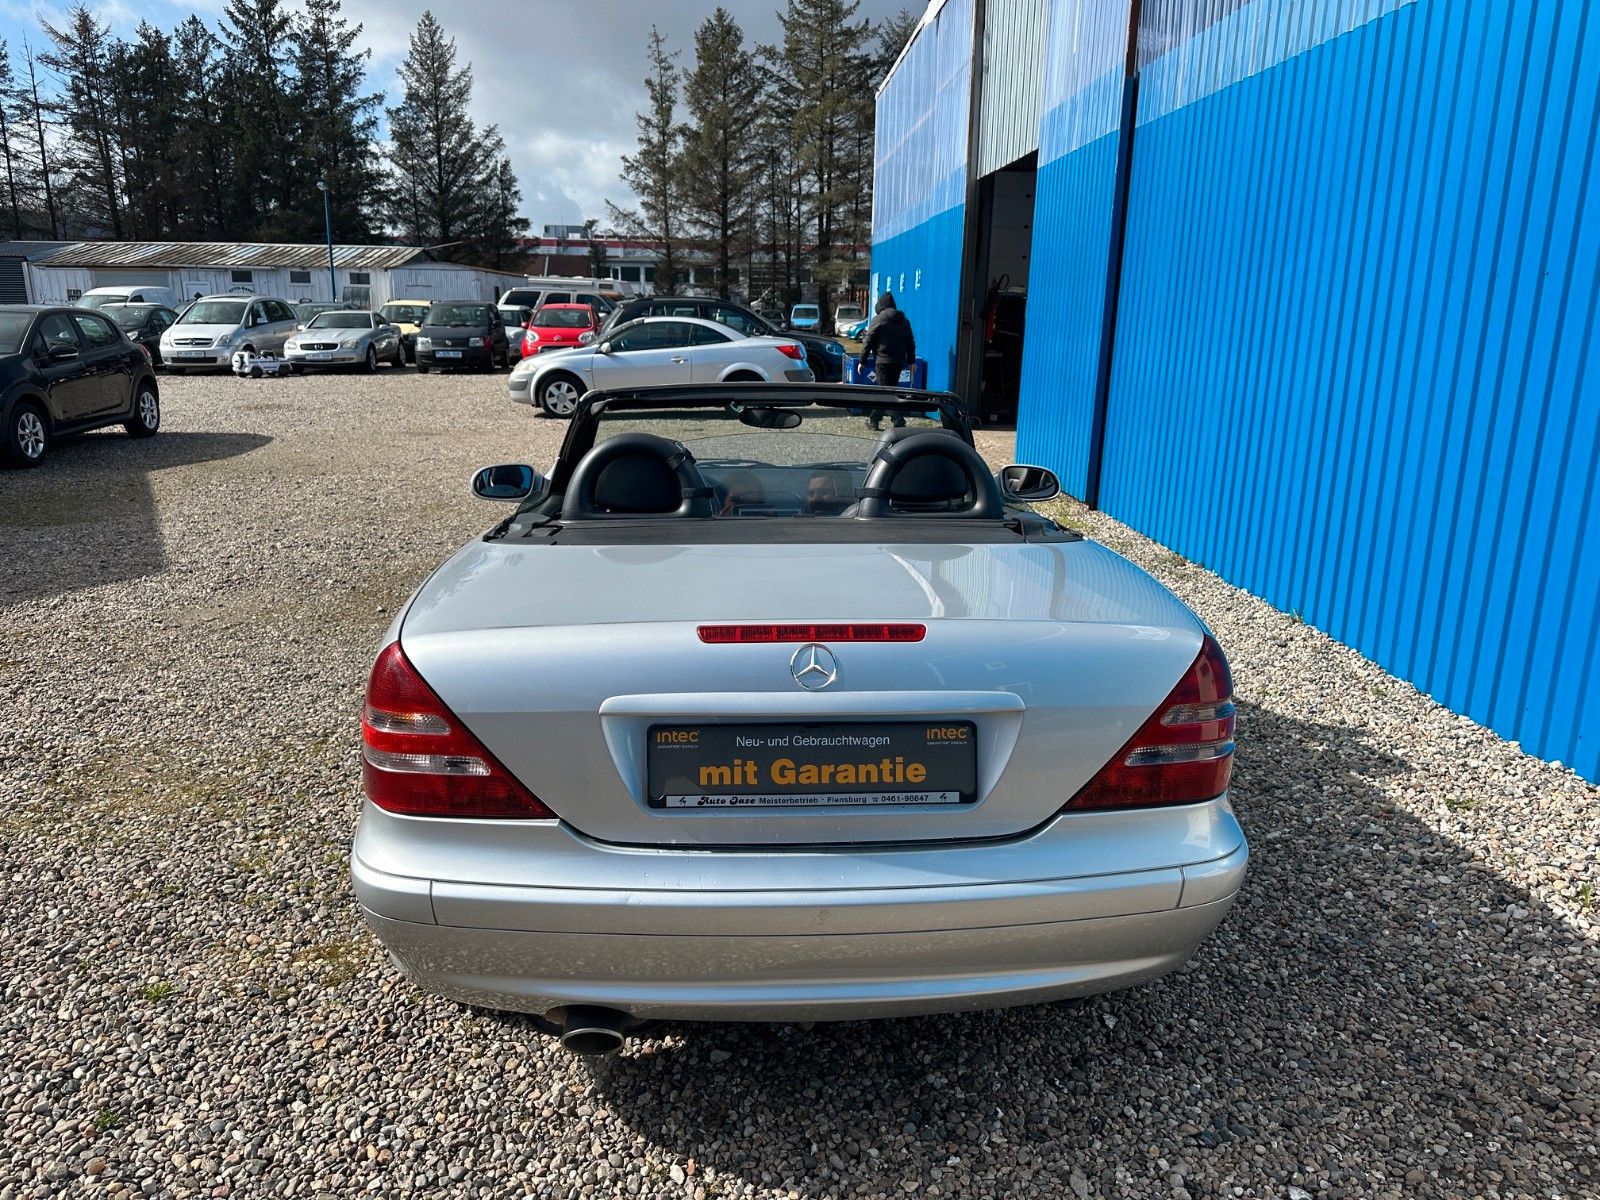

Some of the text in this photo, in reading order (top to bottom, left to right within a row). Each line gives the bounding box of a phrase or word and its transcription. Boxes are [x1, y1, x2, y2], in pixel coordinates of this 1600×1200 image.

[657, 731, 699, 743] intec
[926, 727, 968, 739] intec
[736, 735, 890, 748] Neu- und Gebrauchtwagen
[699, 757, 927, 785] mit Garantie
[697, 796, 726, 806] Auto
[729, 796, 756, 805] Oase
[758, 797, 818, 805] Meisterbetrieb
[826, 796, 867, 804] Flensburg
